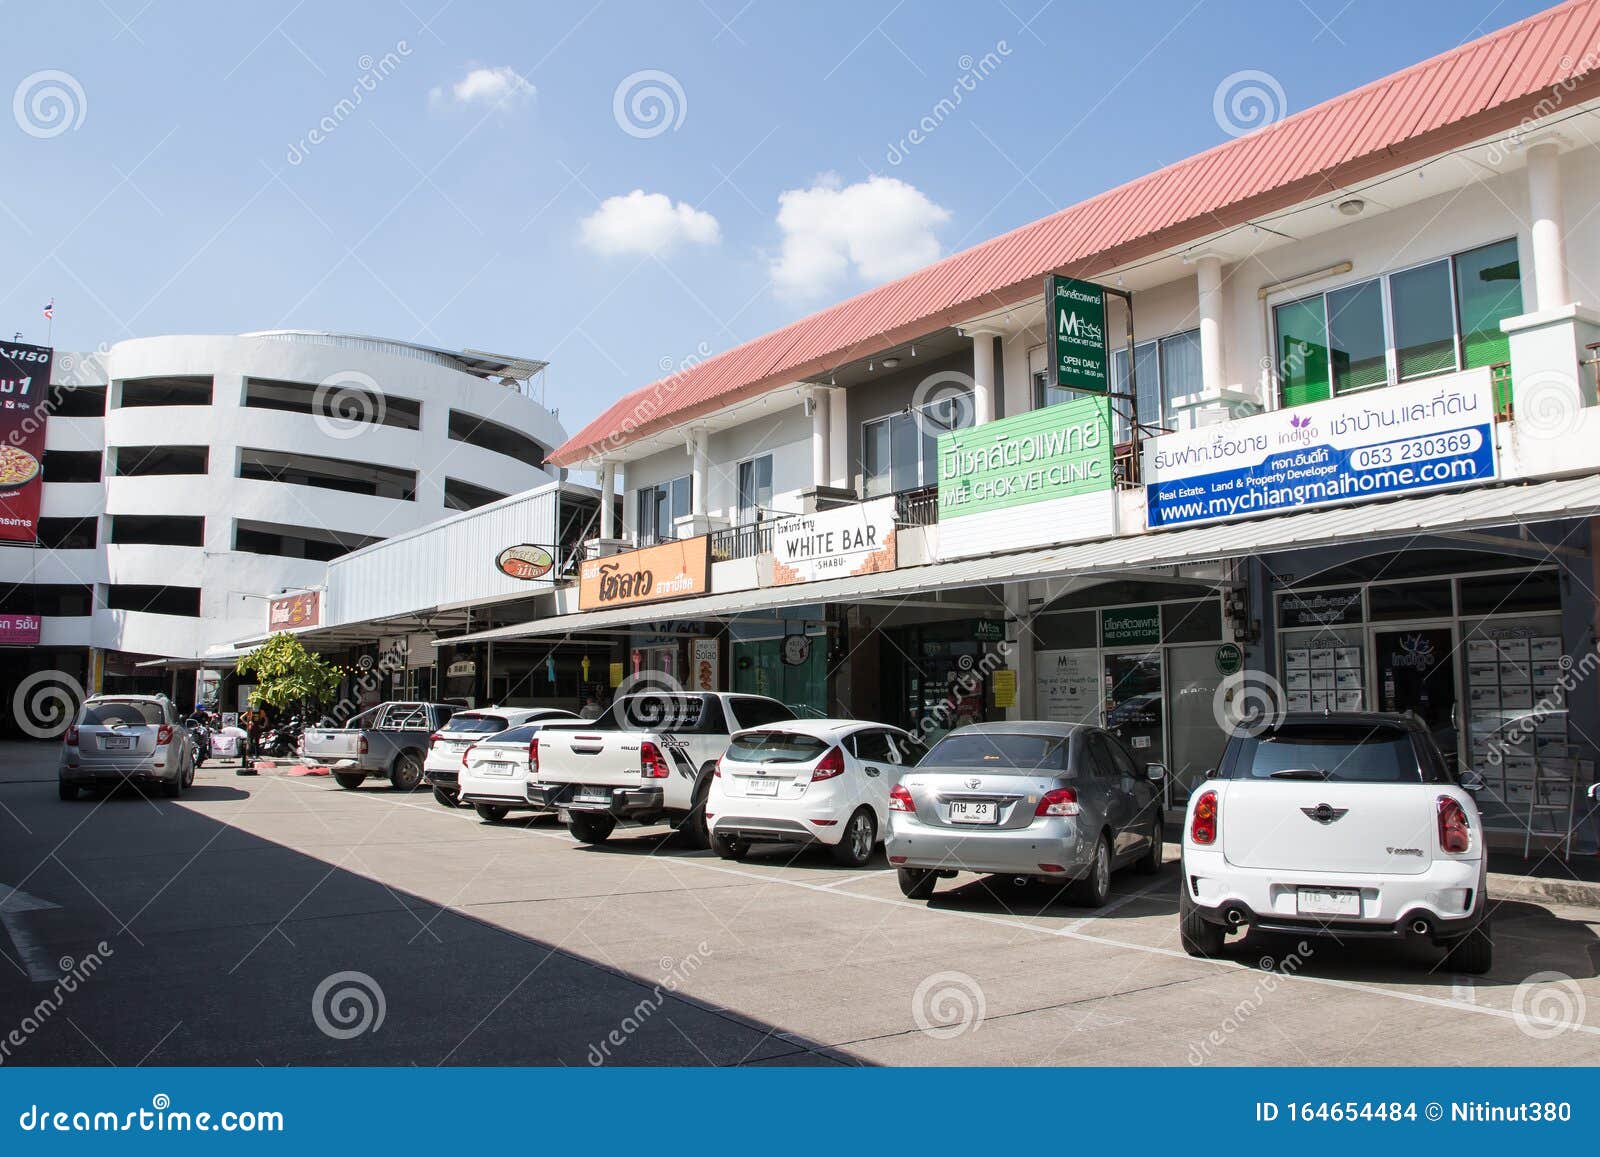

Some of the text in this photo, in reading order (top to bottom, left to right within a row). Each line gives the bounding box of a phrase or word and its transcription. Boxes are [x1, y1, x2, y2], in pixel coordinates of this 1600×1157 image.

[10, 349, 49, 363] 1150
[1063, 355, 1100, 369] OPEN DAILY
[943, 412, 1102, 481] มีโชคสัตวแพทย์
[1278, 427, 1319, 446] indigo
[1359, 433, 1472, 468] 053 230369
[943, 458, 1102, 506] MEE CHOK VET CLINIC
[1159, 489, 1177, 501] Real
[1211, 478, 1234, 493] Land
[1236, 478, 1244, 488] &
[1246, 470, 1285, 489] Property
[1287, 463, 1338, 482] Developer
[1160, 457, 1477, 521] www.mychiangmaihome.com
[786, 524, 877, 558] WHITE BAR
[975, 803, 987, 814] 23
